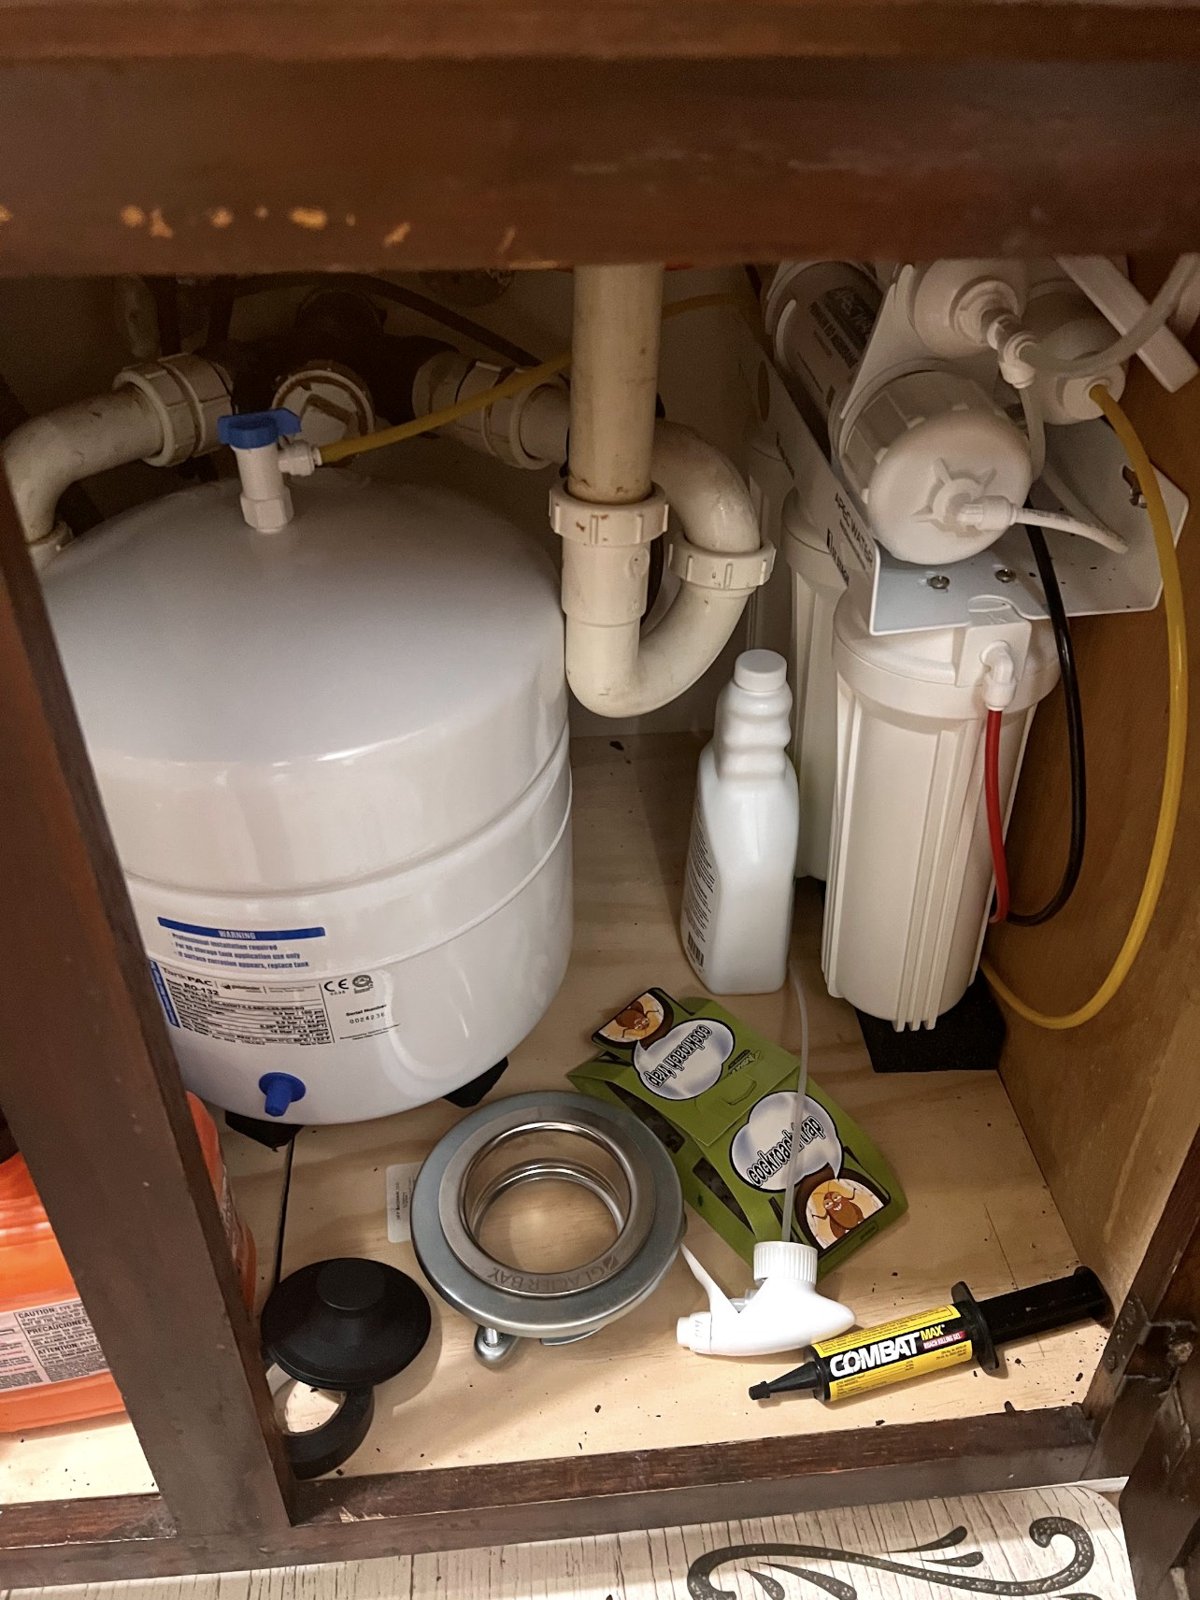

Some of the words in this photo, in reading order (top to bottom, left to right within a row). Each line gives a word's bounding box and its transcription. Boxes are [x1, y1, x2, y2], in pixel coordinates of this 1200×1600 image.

[217, 930, 256, 940] WARNING
[662, 1024, 713, 1072] cockroach
[643, 1062, 678, 1089] trap
[486, 1266, 524, 1290] BAY
[829, 1331, 921, 1378] COMBAT
[921, 1325, 944, 1341] MAX
